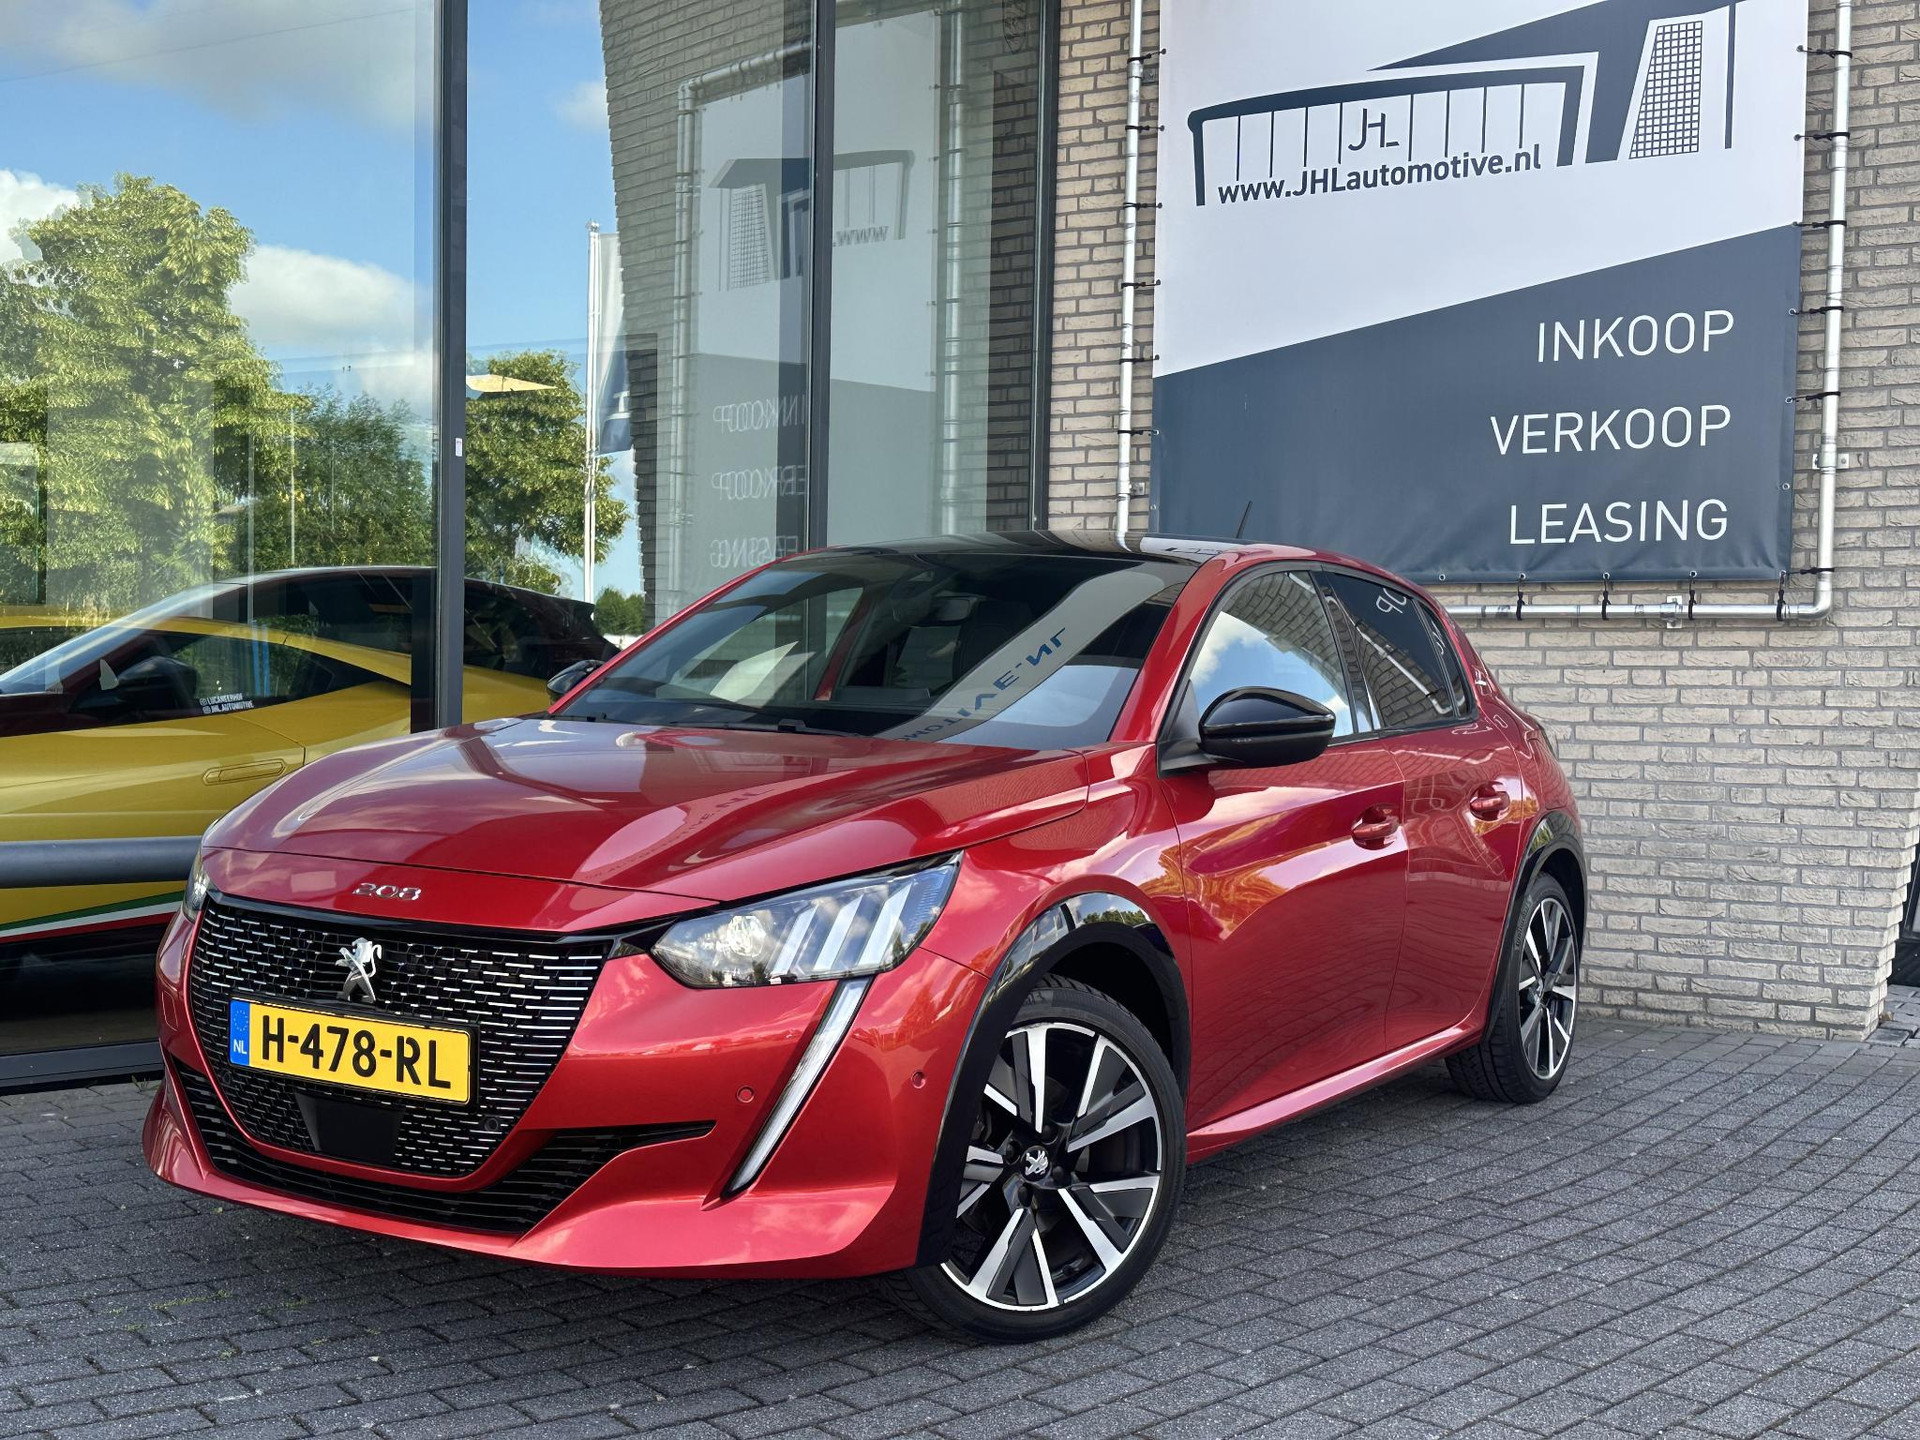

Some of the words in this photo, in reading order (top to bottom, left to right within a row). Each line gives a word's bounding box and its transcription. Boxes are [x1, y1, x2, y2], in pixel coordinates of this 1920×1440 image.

[1348, 108, 1400, 151] JHL
[1218, 143, 1541, 205] www.JHLautomotive.nl
[1538, 309, 1734, 363] INKOOP
[1490, 404, 1731, 455] VERKOOP
[1510, 498, 1728, 545] LEASING
[352, 882, 422, 901] 208
[233, 1038, 248, 1055] NL
[262, 1014, 452, 1090] H-478-RL
